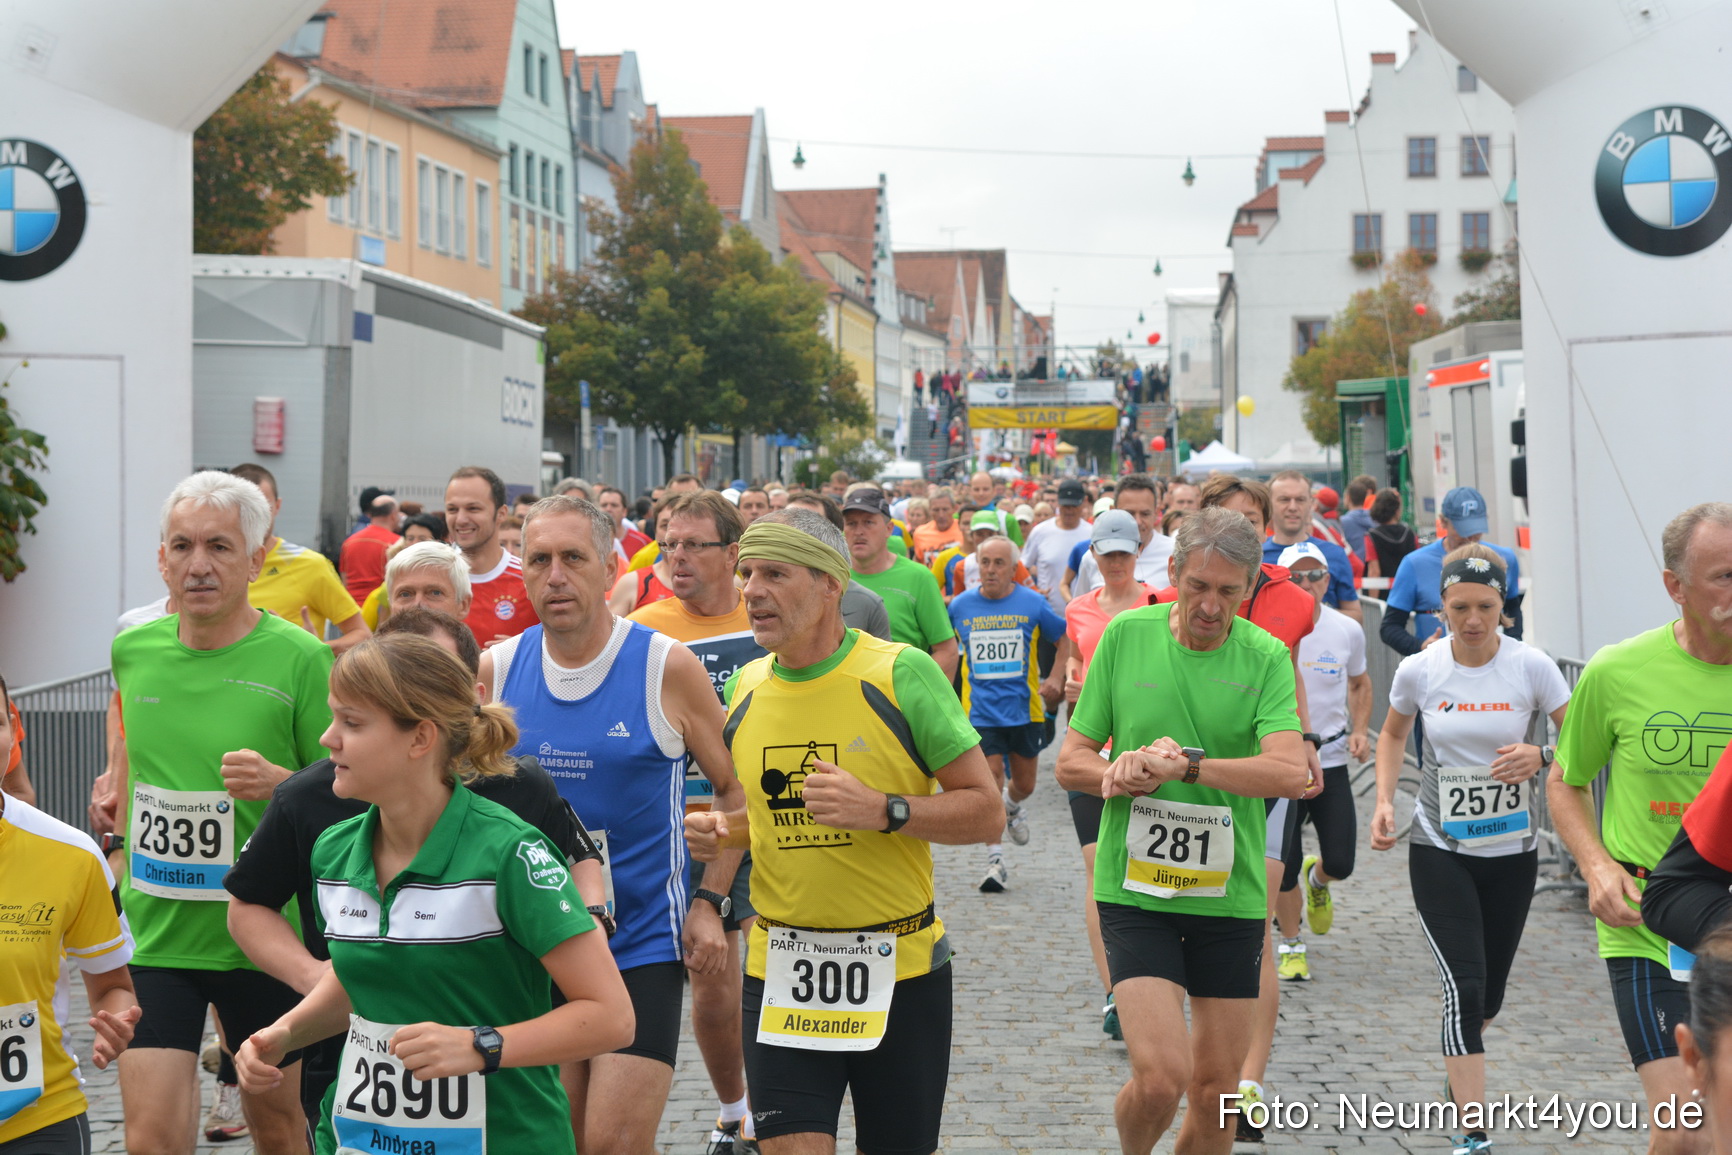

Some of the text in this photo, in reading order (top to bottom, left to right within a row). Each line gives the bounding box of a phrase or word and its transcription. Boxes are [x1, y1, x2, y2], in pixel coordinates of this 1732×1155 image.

[1605, 108, 1732, 161] BMW
[0, 141, 77, 190] MW
[1016, 411, 1068, 424] START
[971, 621, 1018, 631] STADTLAUF
[973, 615, 1029, 624] NEUMARKTER
[976, 642, 1018, 660] 2807
[989, 664, 1006, 672] Gerd
[1457, 703, 1515, 711] KLEBL
[606, 730, 630, 738] adidas
[552, 749, 588, 757] Zimmerei
[1440, 774, 1469, 783] PARTL
[135, 791, 211, 813] PARTL Neumarkt
[1449, 784, 1521, 817] 2573
[772, 811, 817, 827] HIRS
[1133, 805, 1218, 826] PARTL Neumarkt
[139, 811, 221, 858] 2339
[777, 832, 851, 843] APOTHEKE
[1467, 821, 1508, 836] Kerstin
[1147, 823, 1210, 866] 281
[145, 863, 205, 885] Christian
[1153, 869, 1198, 889] Jürgen
[414, 910, 437, 920] Semi
[771, 940, 873, 955] PARTL Neumarkt
[792, 959, 869, 1005] 300
[783, 1014, 867, 1034] Alexander
[350, 1030, 374, 1052] PARTL
[346, 1056, 468, 1120] 2690
[370, 1128, 436, 1155] Andrea
